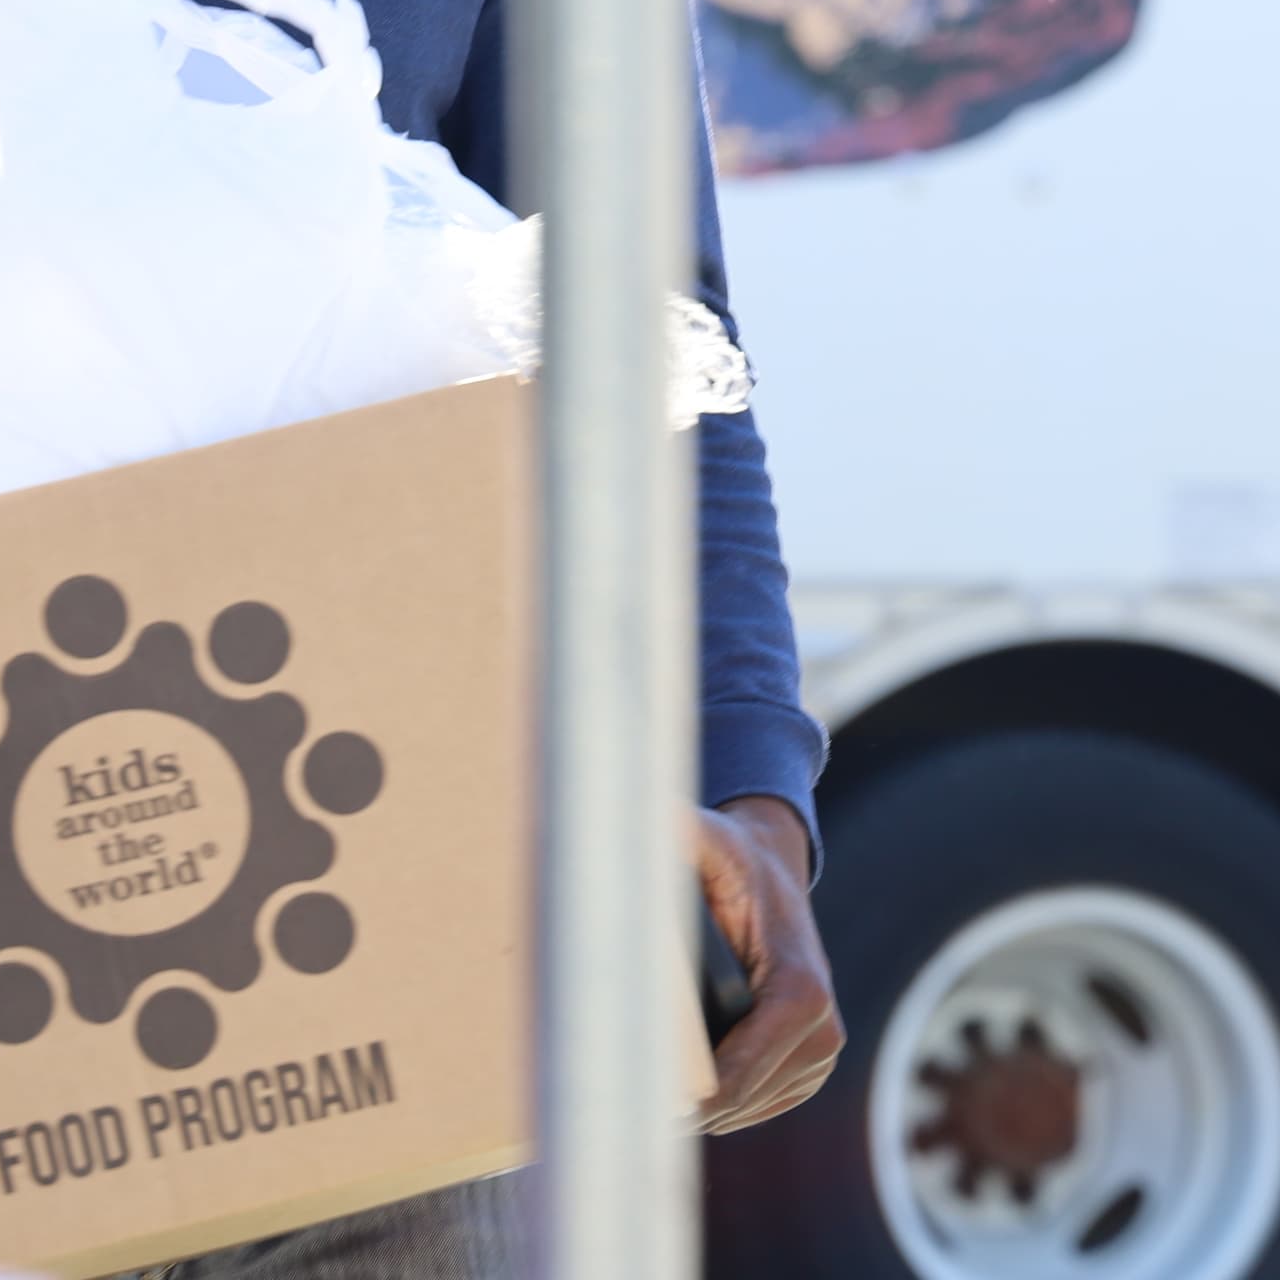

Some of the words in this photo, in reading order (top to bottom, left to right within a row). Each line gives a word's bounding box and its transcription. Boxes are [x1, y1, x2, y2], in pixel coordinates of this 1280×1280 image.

[58, 747, 182, 807] kids
[55, 779, 201, 840] around
[97, 832, 166, 867] the
[138, 1040, 396, 1160] PROGRAM
